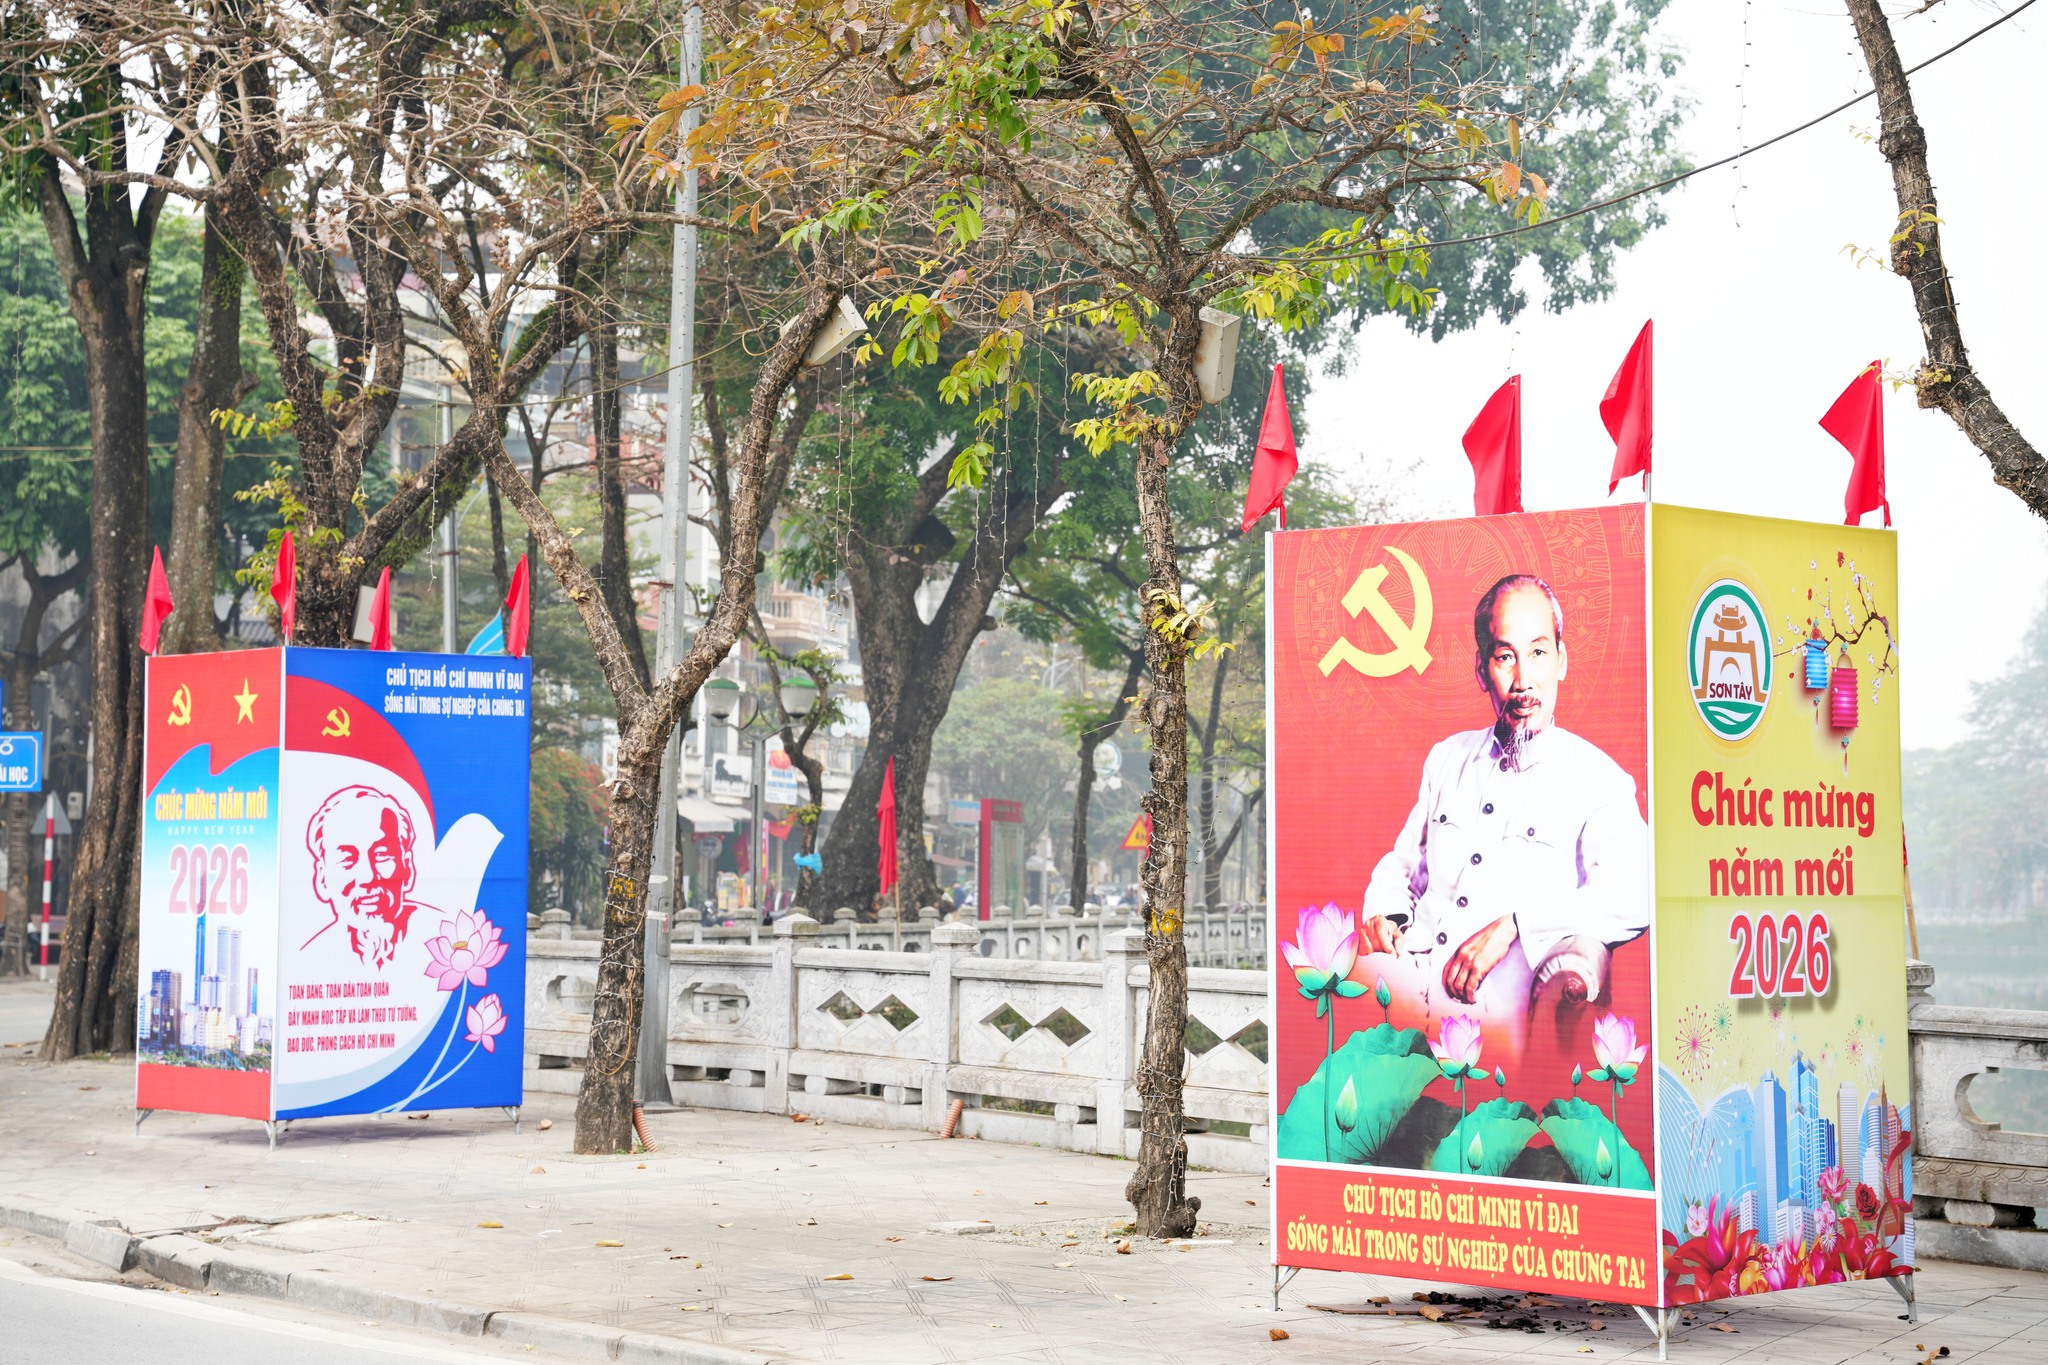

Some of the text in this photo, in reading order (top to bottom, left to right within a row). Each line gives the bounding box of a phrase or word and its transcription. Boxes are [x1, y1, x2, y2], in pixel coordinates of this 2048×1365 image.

[386, 663, 407, 686] CHỦ
[409, 669, 431, 690] TỊCH
[449, 667, 466, 688] CHÍ
[468, 671, 494, 689] MINH
[495, 669, 506, 690] VĨ
[507, 672, 524, 694] ĐẠI
[1709, 681, 1753, 700] SƠN TÂY
[384, 690, 404, 714] SỐNG
[404, 693, 418, 714] MÃI
[419, 697, 441, 715] TRONG
[441, 696, 452, 719] SỰ
[452, 695, 477, 719] NGHIỆP
[477, 693, 491, 716] CỦA
[491, 696, 514, 717] CHÚNG
[8, 766, 28, 786] HỌC
[155, 785, 268, 821] CHÚC MỪNG NĂM MỚI
[1691, 770, 1875, 838] Chúc mừng
[167, 824, 255, 836] HAPPY NEW YEAR
[168, 844, 249, 916] 2026
[1709, 844, 1854, 896] năm mới
[1728, 909, 1832, 999] 2026
[372, 1007, 386, 1022] THEO
[317, 1035, 338, 1052] PHONG
[339, 1032, 356, 1050] CÁCH
[367, 1031, 378, 1049] CHÍ
[379, 1032, 395, 1049] MINH
[1343, 1176, 1579, 1240] CHỦ TỊCH HỒ CHÍ MINH VĨ ĐẠI
[1287, 1214, 1646, 1290] SỐNG MÃI TRONG SỰ NGHIỆP CỦA CHÚNG TA!
